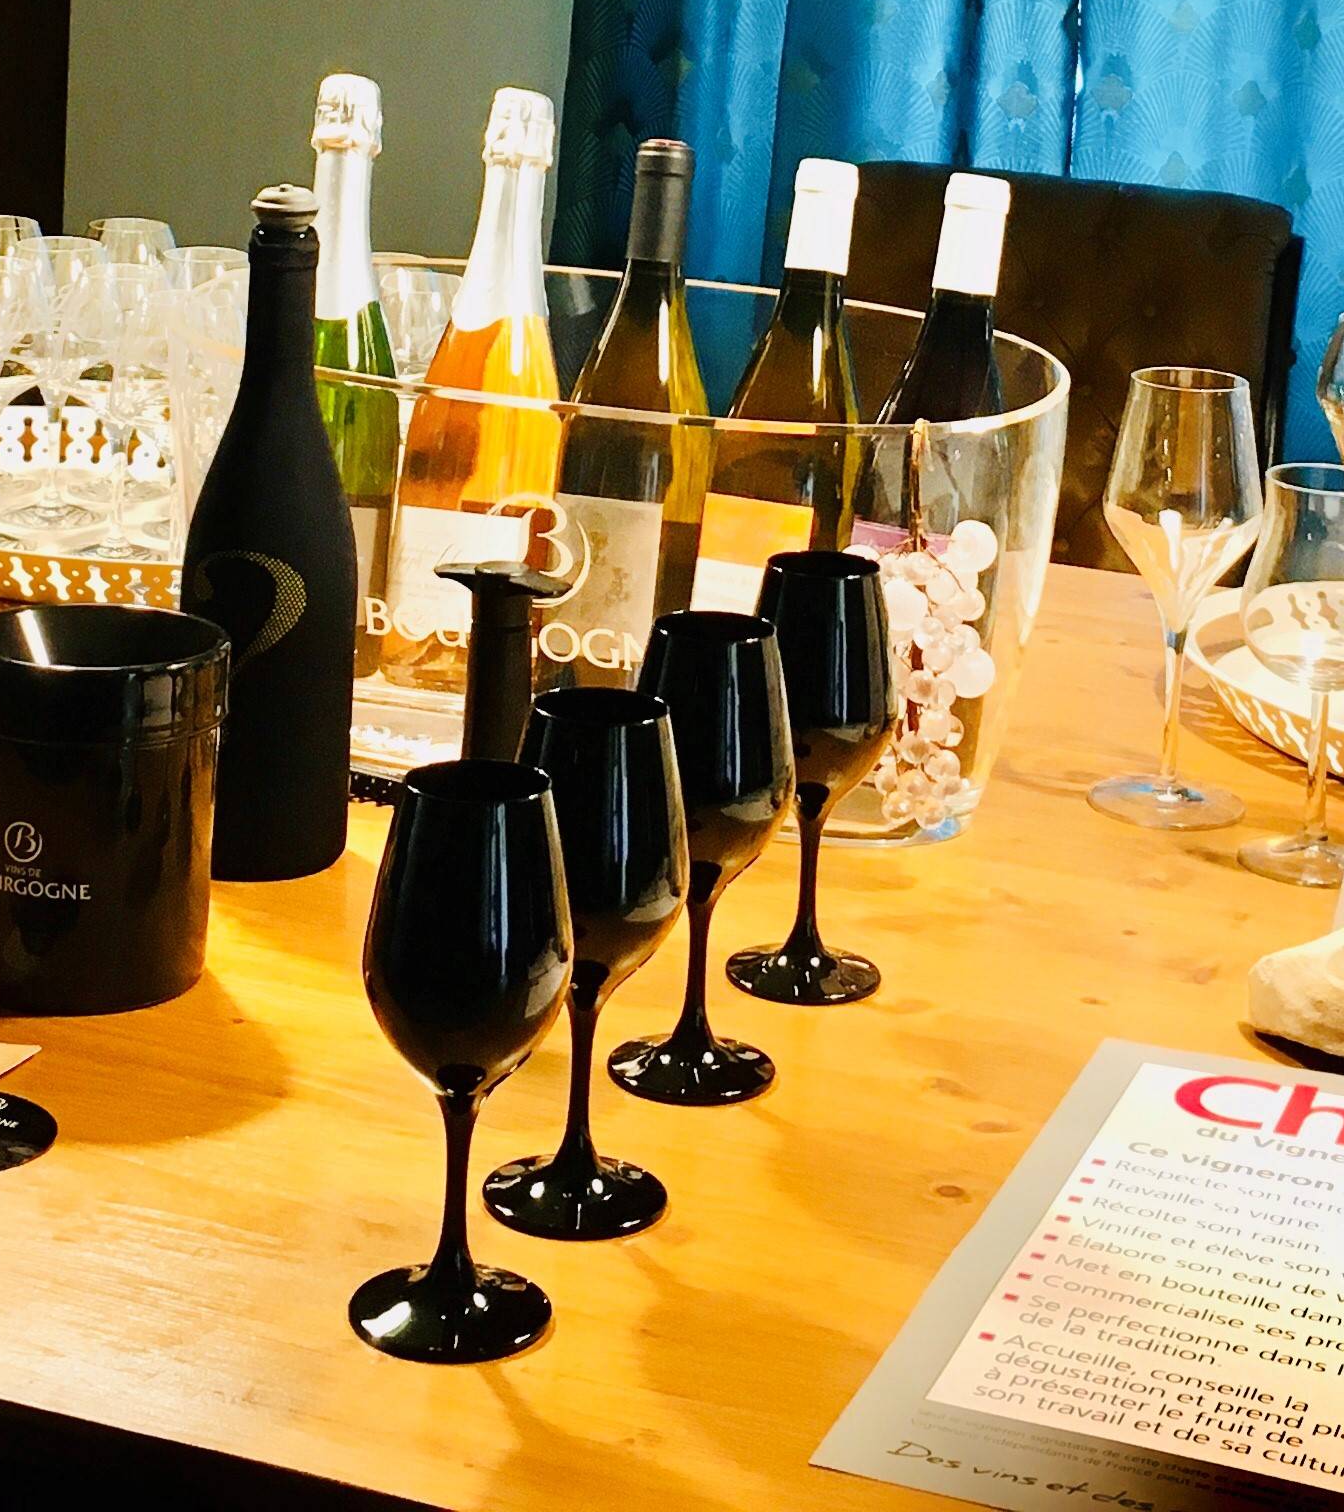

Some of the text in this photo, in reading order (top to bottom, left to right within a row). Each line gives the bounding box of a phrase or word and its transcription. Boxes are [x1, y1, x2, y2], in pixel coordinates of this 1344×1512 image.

[1196, 1122, 1240, 1145] du
[1105, 1177, 1206, 1208] Travaille
[1212, 1201, 1241, 1216] sa
[1115, 1158, 1283, 1204] Respecte son
[1127, 1140, 1337, 1194] Ce vigneron
[1081, 1214, 1164, 1245] Vinifie
[1169, 1233, 1199, 1251] et
[1204, 1241, 1276, 1268] élève
[1282, 1260, 1331, 1279] son
[1091, 1195, 1189, 1228] Récolte
[1195, 1220, 1243, 1238] son
[1053, 1252, 1112, 1279] Met
[1119, 1267, 1153, 1286] en
[1160, 1275, 1282, 1314] bouteille
[1066, 1233, 1168, 1267] Élabore
[1175, 1258, 1224, 1278] son
[1231, 1270, 1284, 1291] eau
[1291, 1281, 1329, 1301] de
[1027, 1293, 1062, 1313] Se
[1067, 1302, 1251, 1357] perfectionne
[1258, 1346, 1327, 1376] dans
[1041, 1273, 1247, 1331] Commercialise
[1254, 1320, 1297, 1343] ses
[1018, 1310, 1224, 1370] de la tradition.
[993, 1348, 1169, 1402] dégustation
[1175, 1388, 1207, 1409] et
[1213, 1399, 1306, 1432] prend
[1002, 1333, 1311, 1415] Accueille, conseille la
[971, 1383, 1027, 1408] son
[1036, 1395, 1127, 1429] travail
[1133, 1416, 1164, 1436] et
[1171, 1424, 1212, 1446] de
[1219, 1437, 1253, 1457] sa
[982, 1365, 1306, 1451] à présenter le fruit de
[887, 1439, 963, 1470] Des
[972, 1464, 1040, 1487] vins
